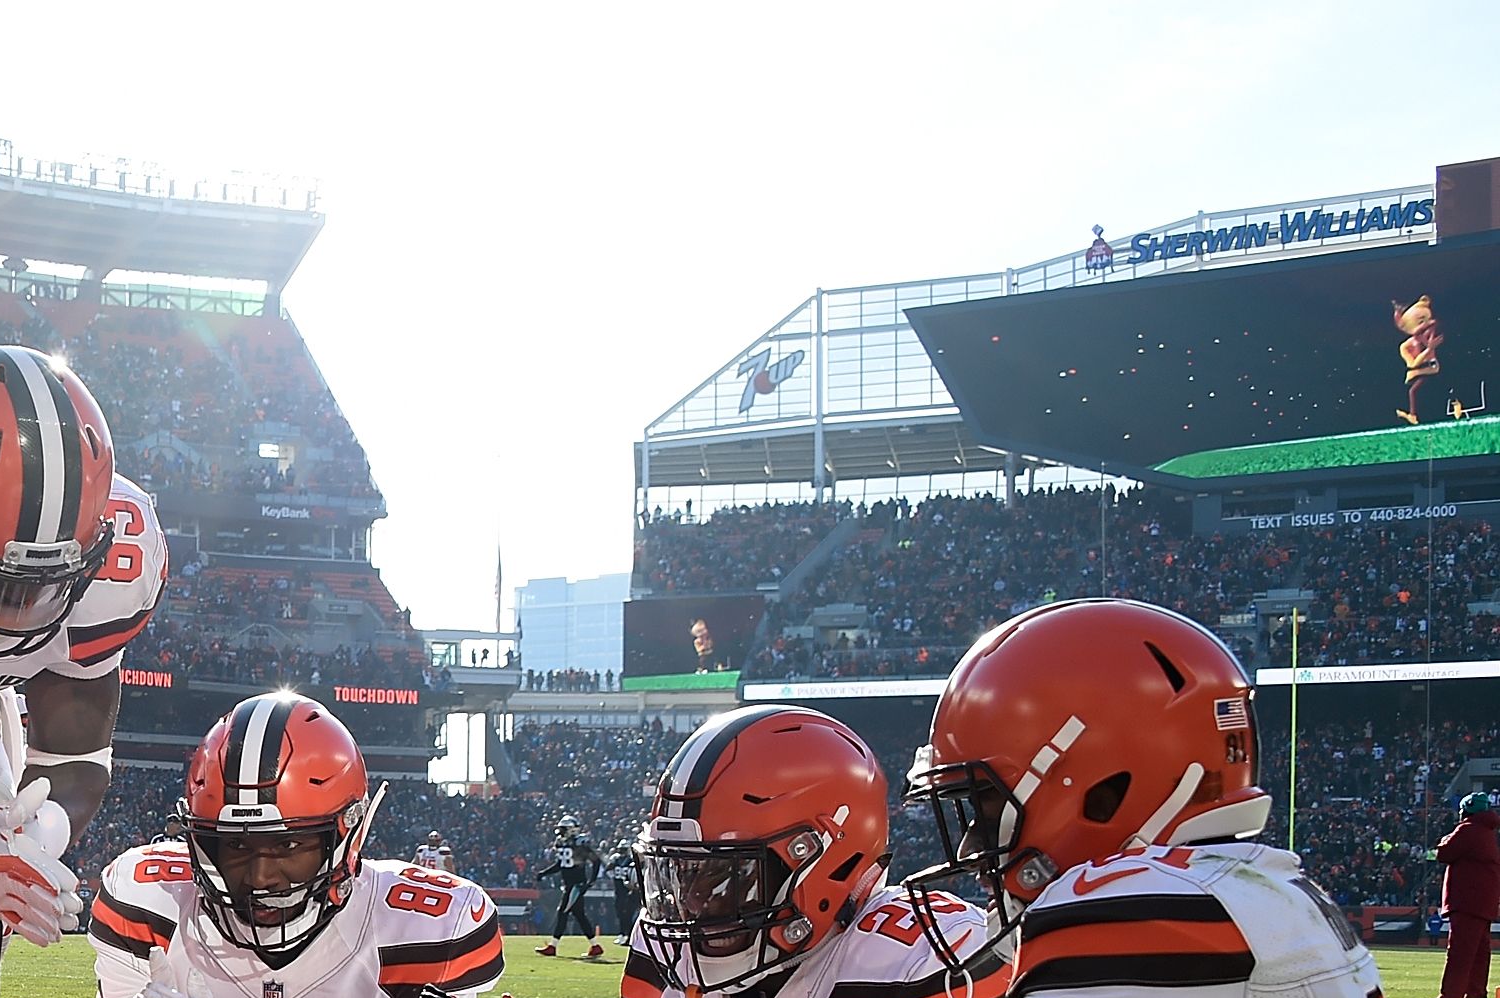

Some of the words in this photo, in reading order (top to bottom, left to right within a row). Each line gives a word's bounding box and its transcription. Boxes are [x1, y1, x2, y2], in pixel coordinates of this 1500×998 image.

[1127, 199, 1434, 264] SHERWIN-WILLIAMS
[262, 505, 310, 519] KeyBank
[1250, 516, 1282, 529] TEXT
[1291, 513, 1335, 527] ISSUES
[1343, 511, 1362, 523] TO
[1369, 505, 1457, 522] 440-824-6000
[120, 669, 172, 688] UCHDOWN
[1319, 668, 1400, 681] PARAMOUNT
[334, 686, 418, 705] TOUCHDOWN
